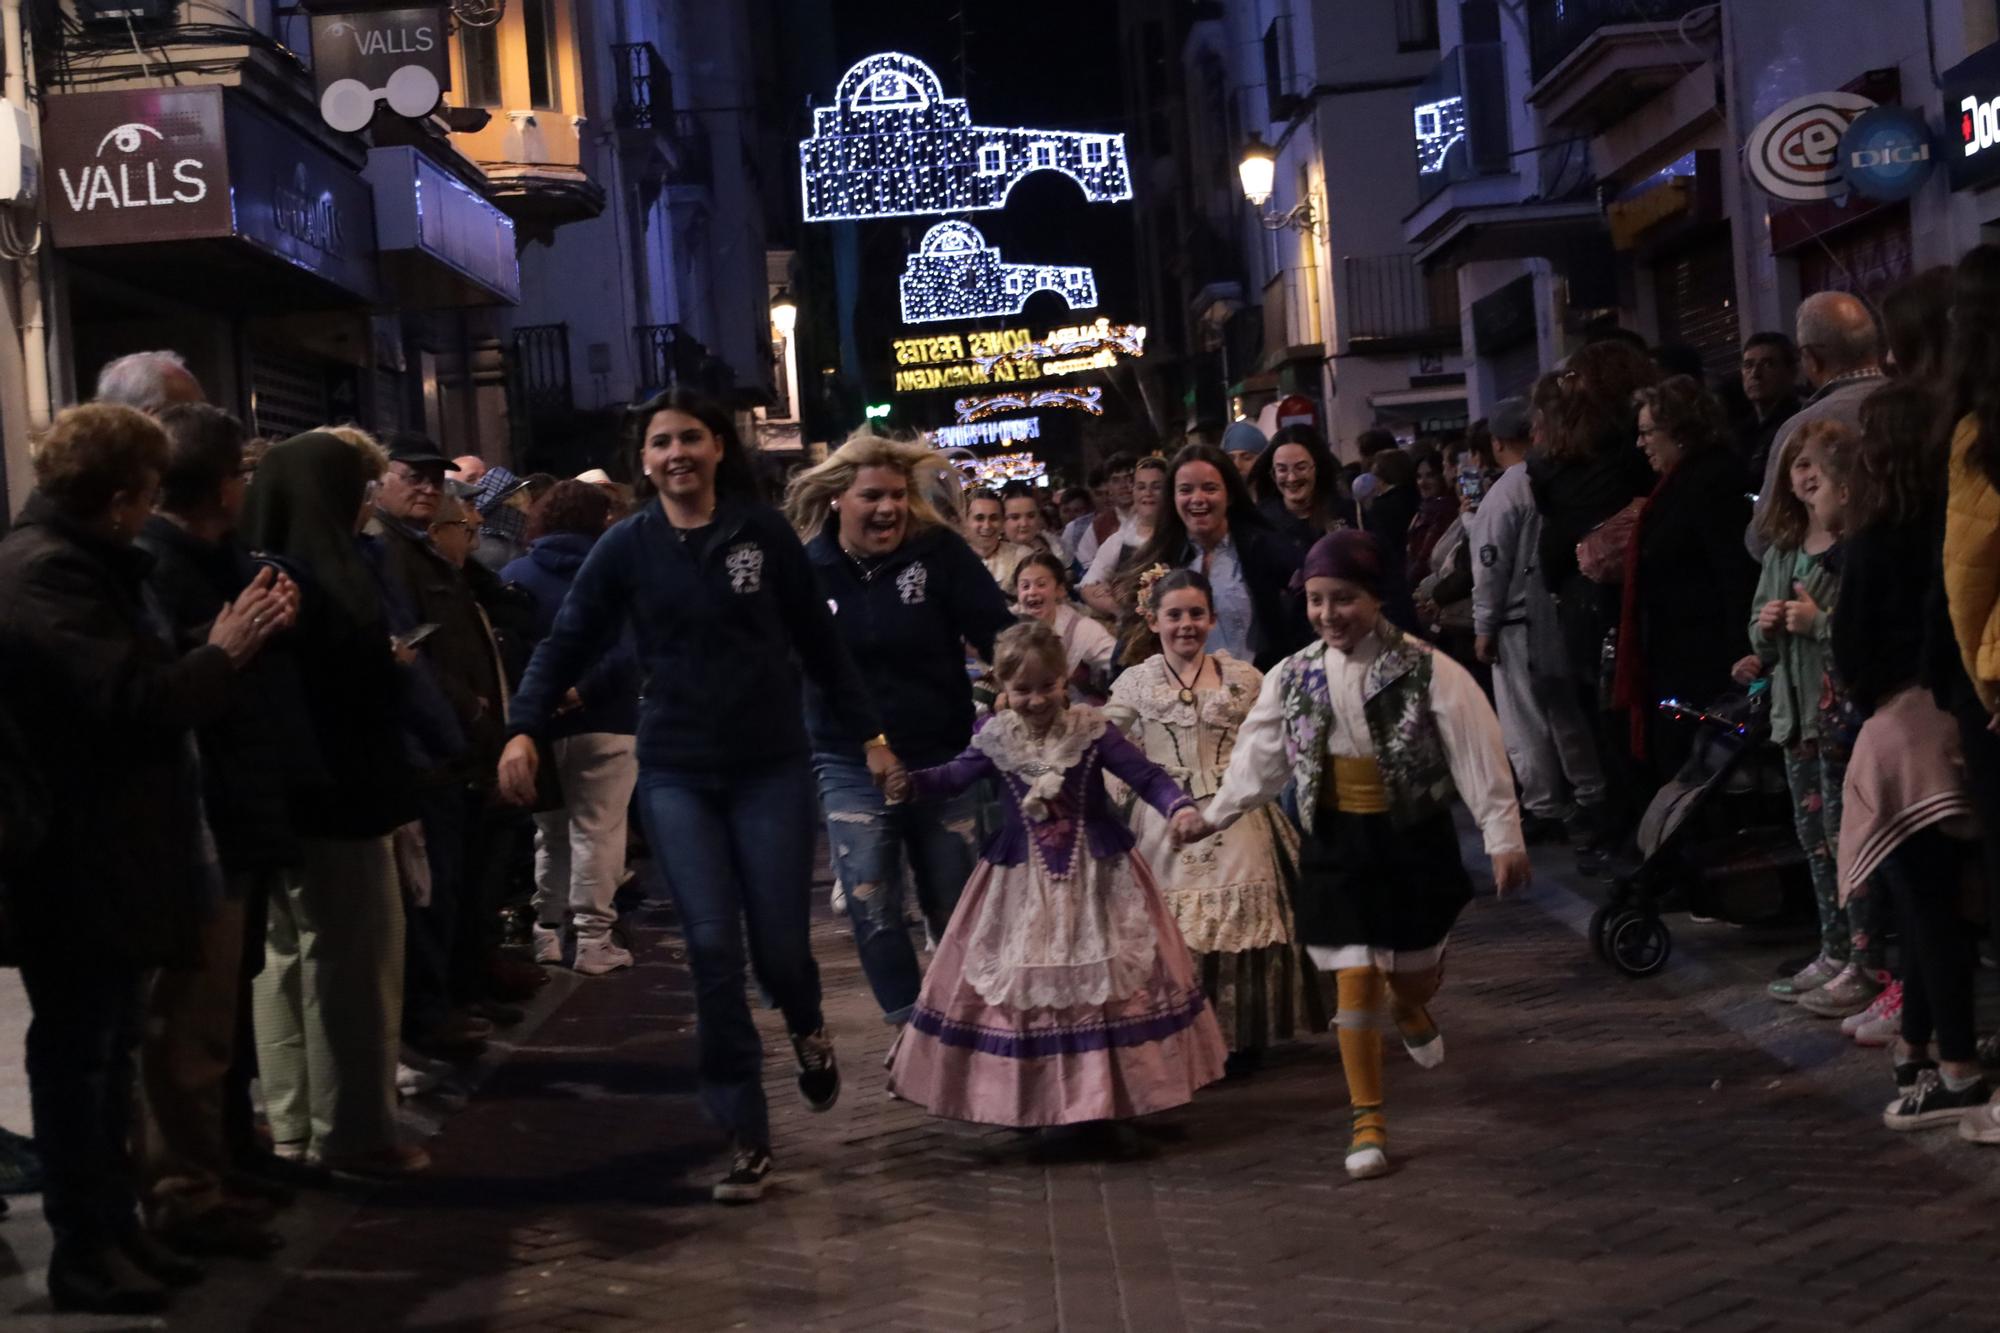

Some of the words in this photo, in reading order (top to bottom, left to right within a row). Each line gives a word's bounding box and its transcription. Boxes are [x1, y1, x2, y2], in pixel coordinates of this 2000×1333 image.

[354, 26, 434, 56] VALLS
[1851, 142, 1931, 169] DIGI
[58, 157, 207, 212] VALLS
